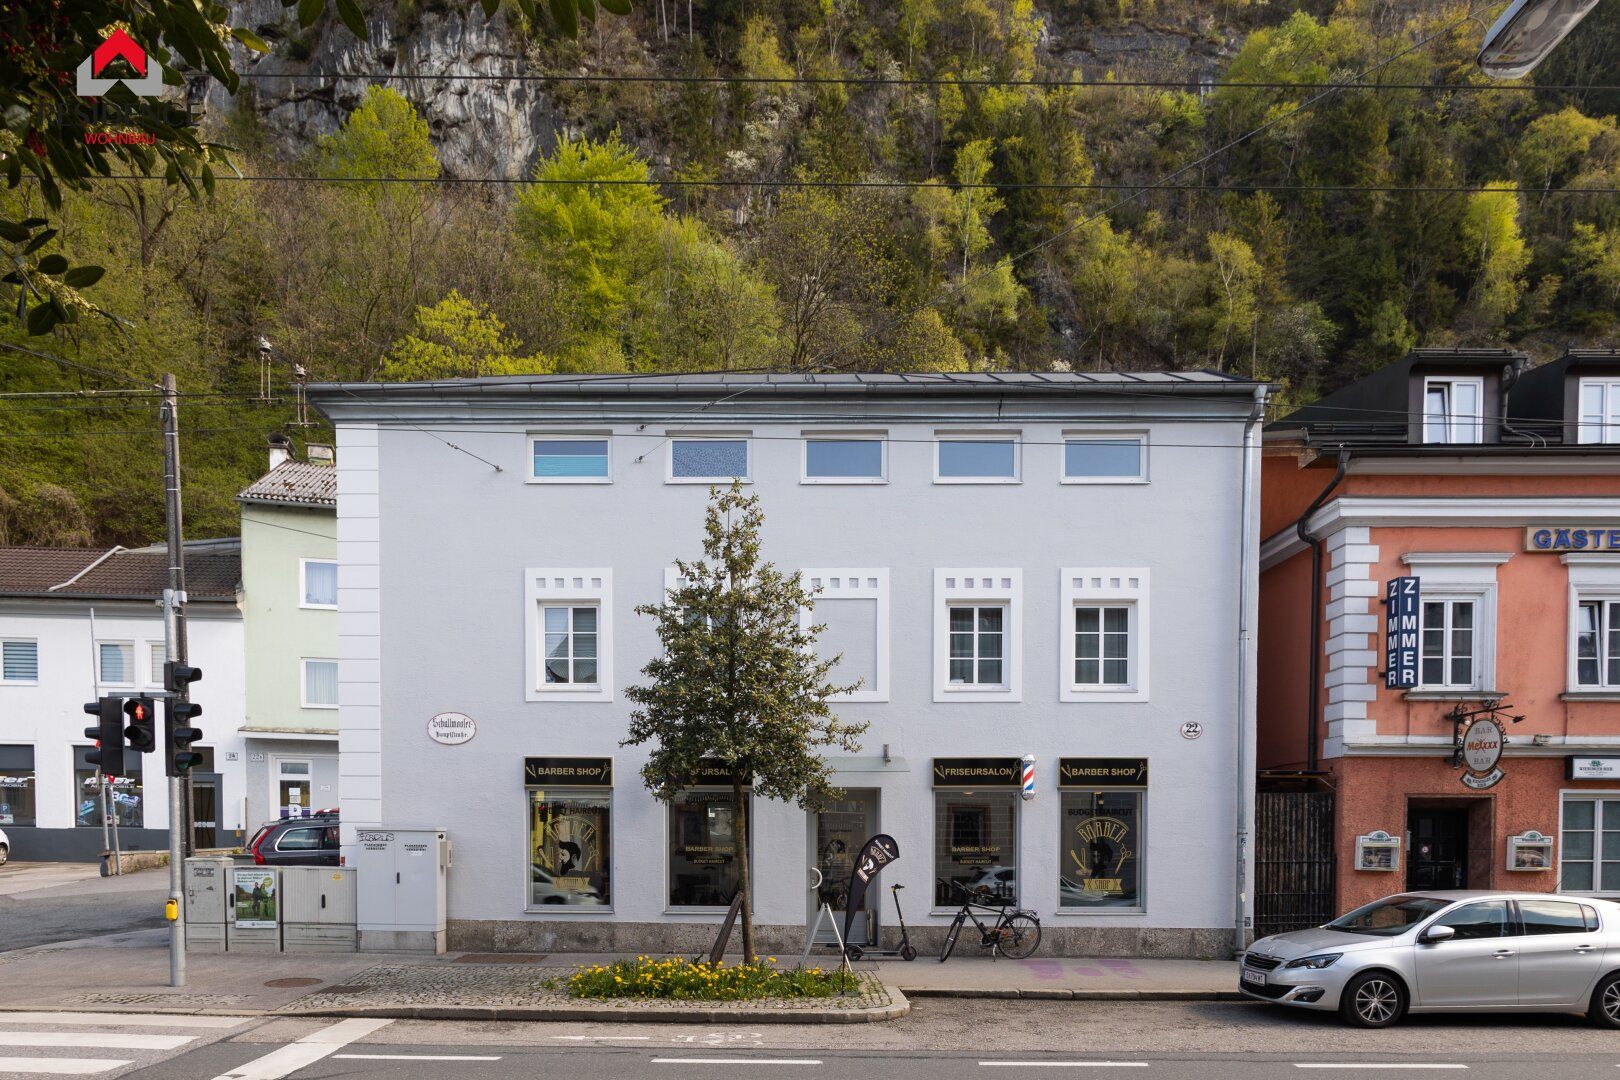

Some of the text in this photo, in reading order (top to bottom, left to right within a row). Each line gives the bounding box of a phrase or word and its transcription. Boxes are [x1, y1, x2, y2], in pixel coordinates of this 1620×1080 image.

[1388, 581, 1398, 686] ZIMMER
[1401, 579, 1417, 684] ZIMMER
[1186, 723, 1198, 733] 22
[1475, 727, 1492, 735] BAR
[1474, 757, 1491, 765] BAR
[538, 767, 602, 776] BARBER SHOP
[945, 767, 1012, 776] FRISEURSALON
[1072, 768, 1136, 776] BARBER SHOP
[1078, 821, 1127, 843] BARBER
[1094, 880, 1111, 890] SHOP
